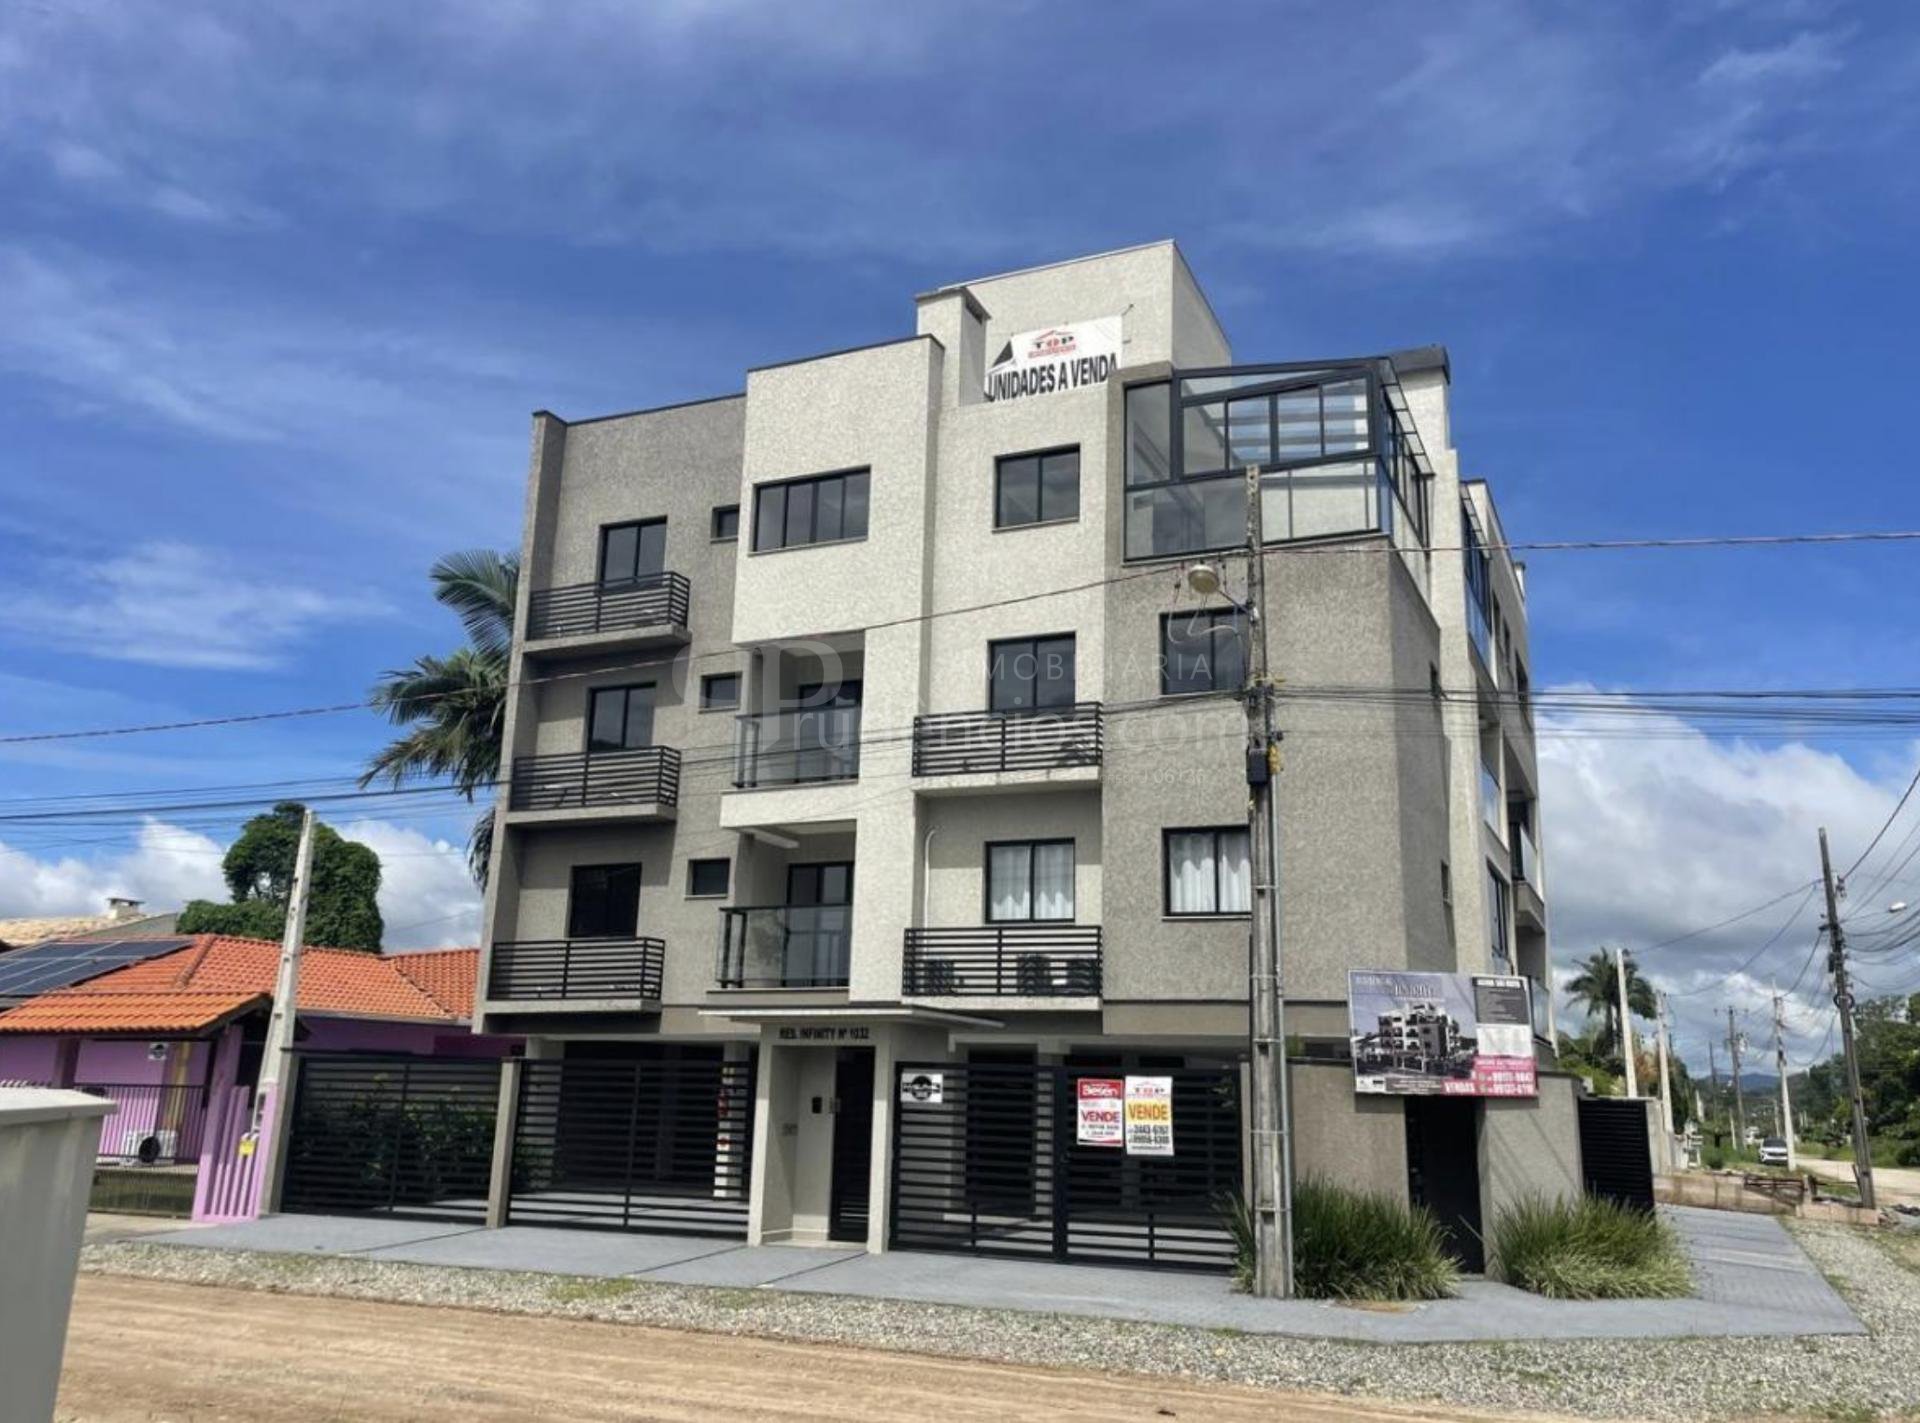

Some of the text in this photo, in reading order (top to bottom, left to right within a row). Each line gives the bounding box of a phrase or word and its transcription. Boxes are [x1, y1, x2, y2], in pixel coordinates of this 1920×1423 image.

[985, 363, 1056, 402] UNIDADES
[1058, 362, 1068, 391] A
[1081, 1110, 1120, 1123] VENDE
[1128, 1103, 1168, 1121] VENDE
